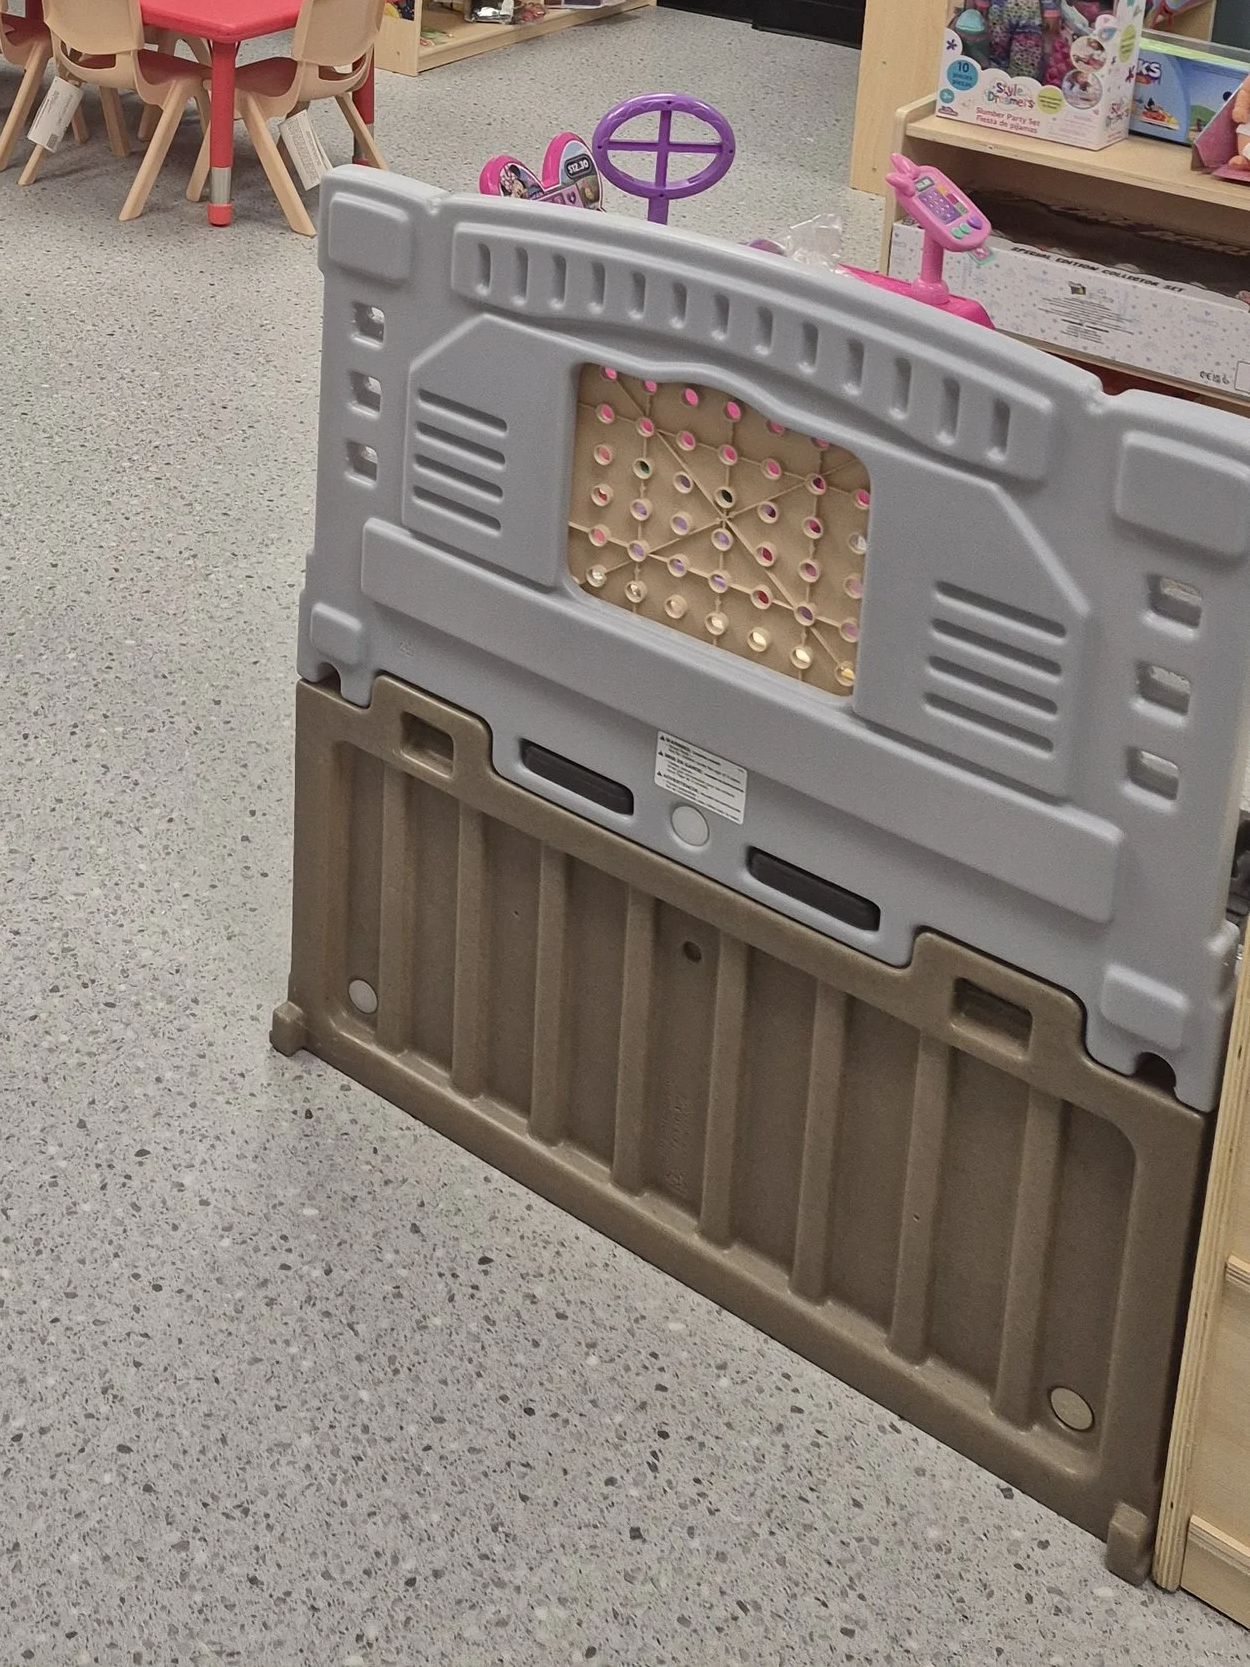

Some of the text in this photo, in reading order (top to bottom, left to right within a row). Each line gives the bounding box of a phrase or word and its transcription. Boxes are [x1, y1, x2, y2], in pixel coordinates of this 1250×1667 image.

[957, 62, 970, 73] 10
[995, 82, 1024, 97] Style
[986, 91, 1035, 109] Dreamers
[976, 107, 1040, 126] Slumber Party Set
[976, 115, 1037, 134] Fiesta de pijamas
[567, 159, 589, 174] $12.30
[1011, 245, 1184, 294] SPECIAL EDITION COLLECTOR SET
